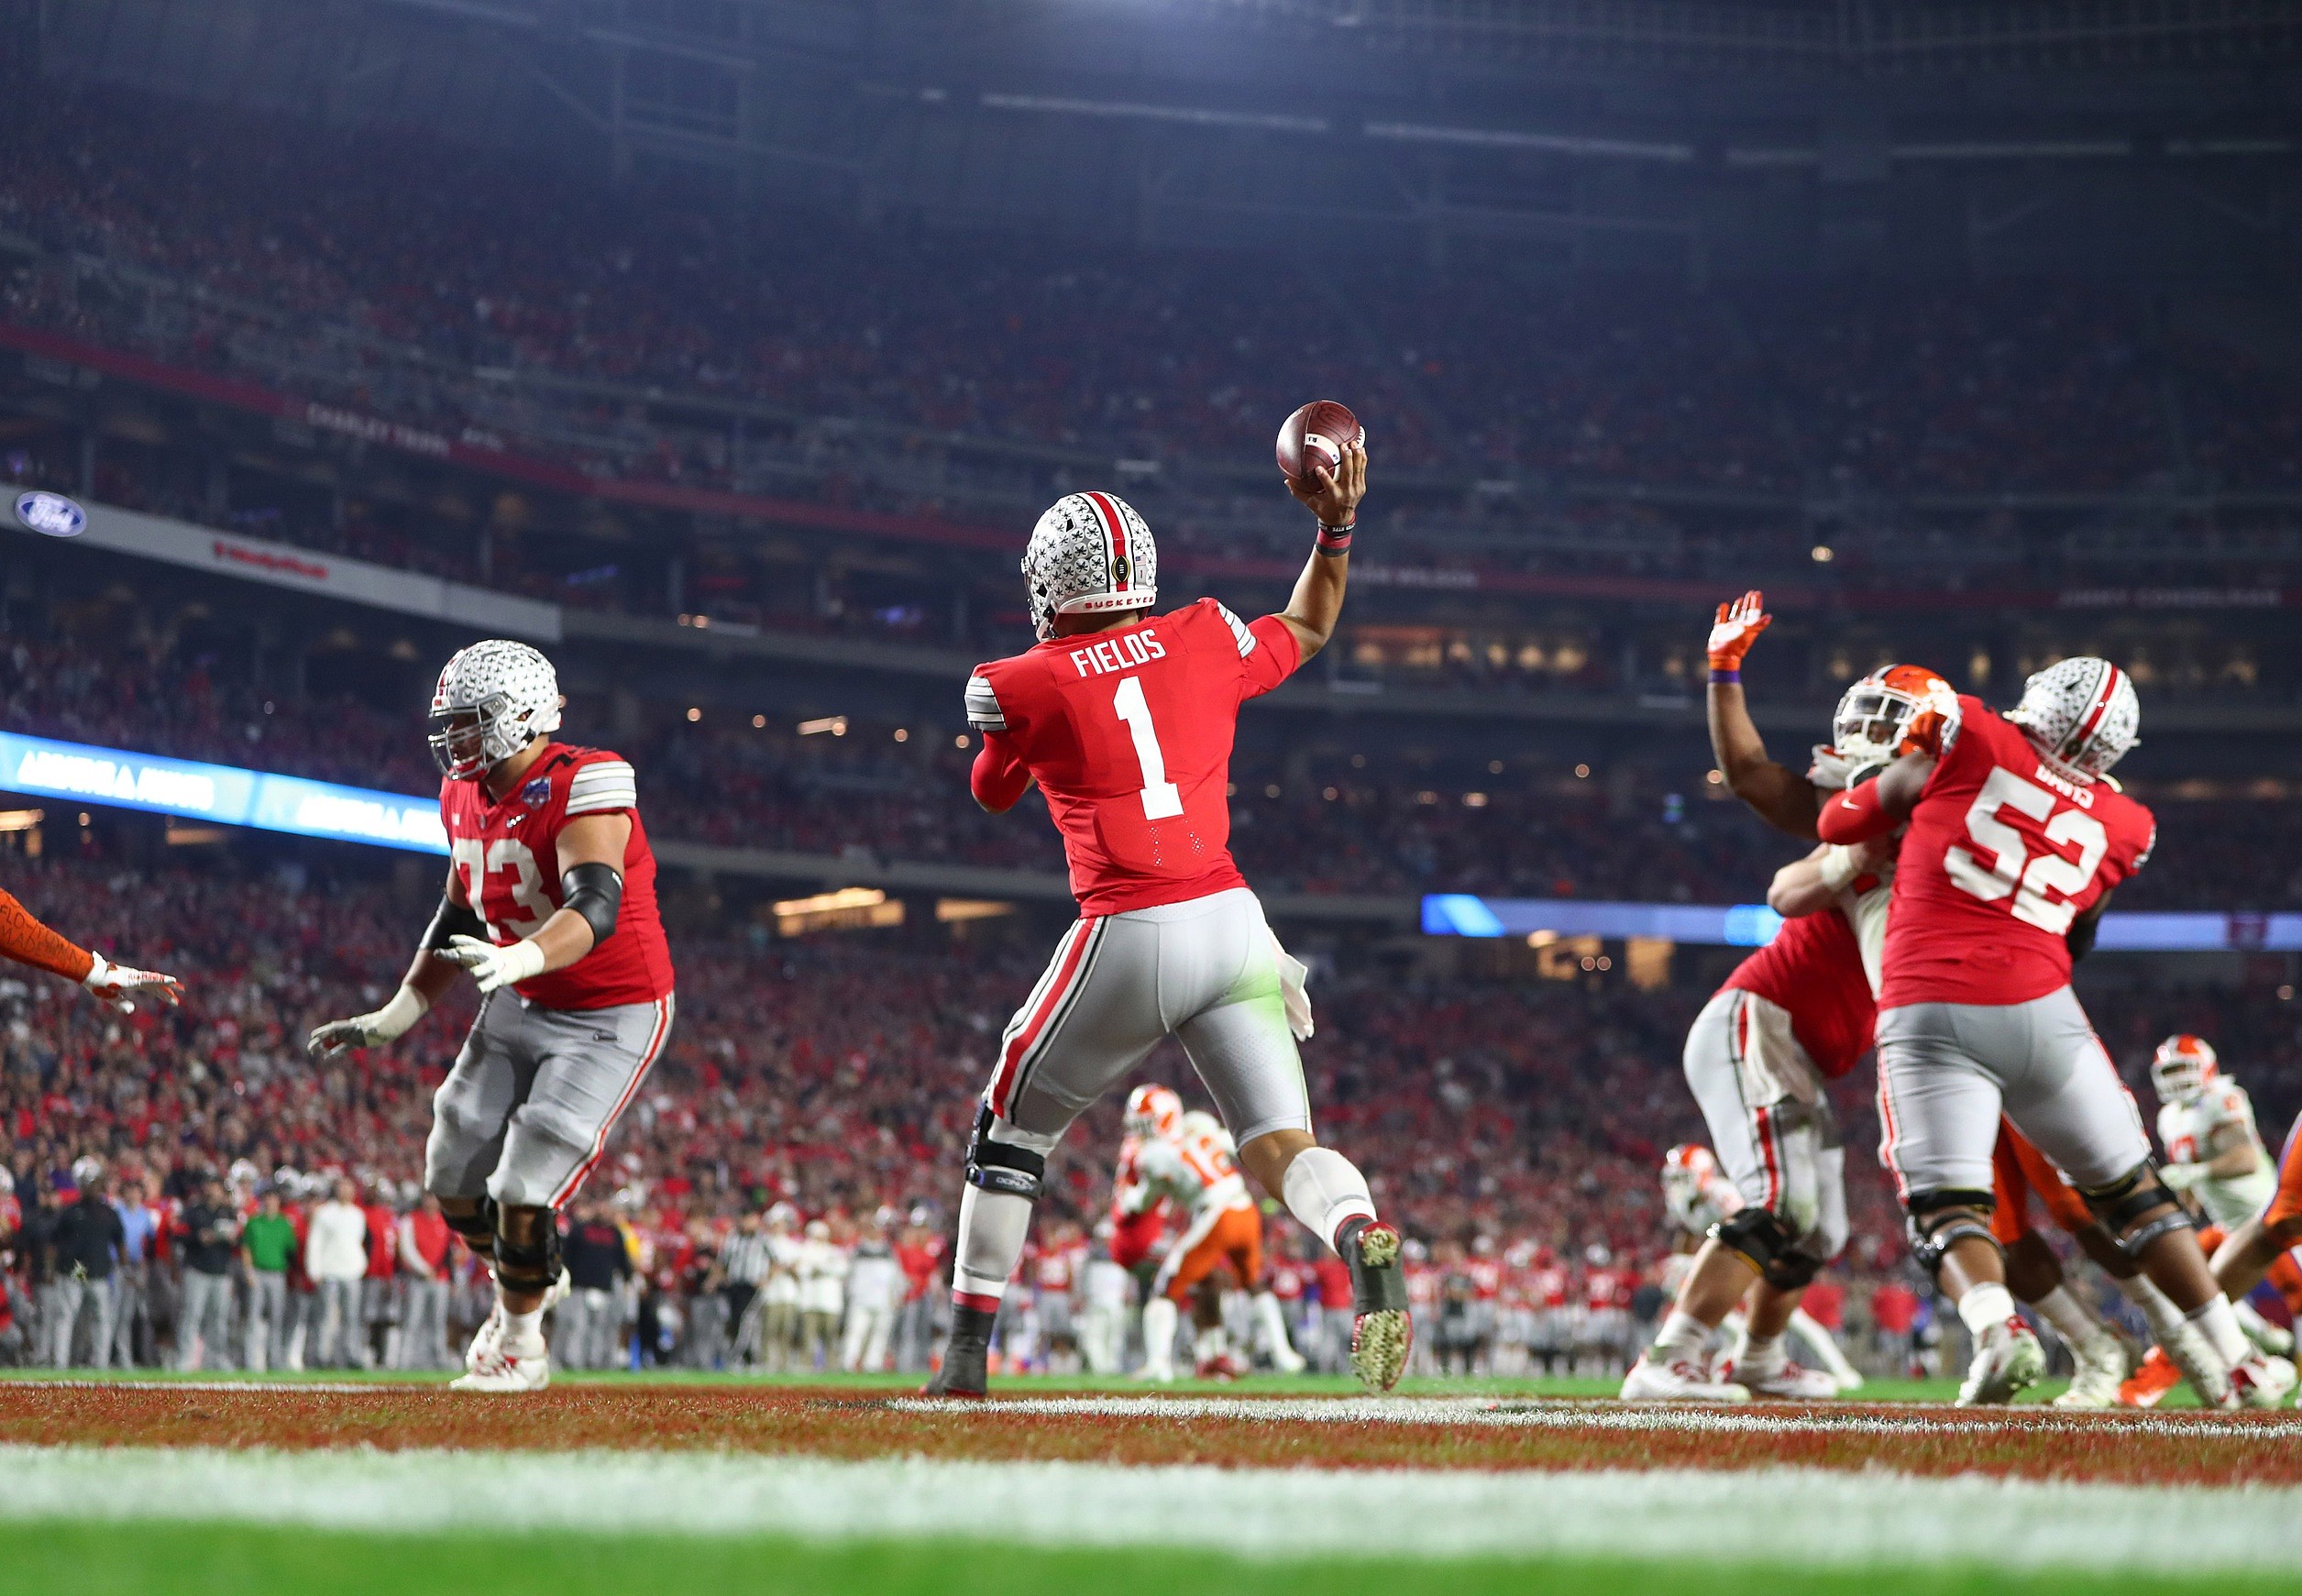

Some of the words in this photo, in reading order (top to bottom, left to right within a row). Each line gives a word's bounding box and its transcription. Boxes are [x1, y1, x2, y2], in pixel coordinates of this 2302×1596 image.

[1069, 629, 1167, 677] FIELDS
[1085, 596, 1154, 610] BUCKEYES
[1112, 675, 1185, 821] 1
[452, 836, 556, 942] 73
[1943, 765, 2109, 936] 52
